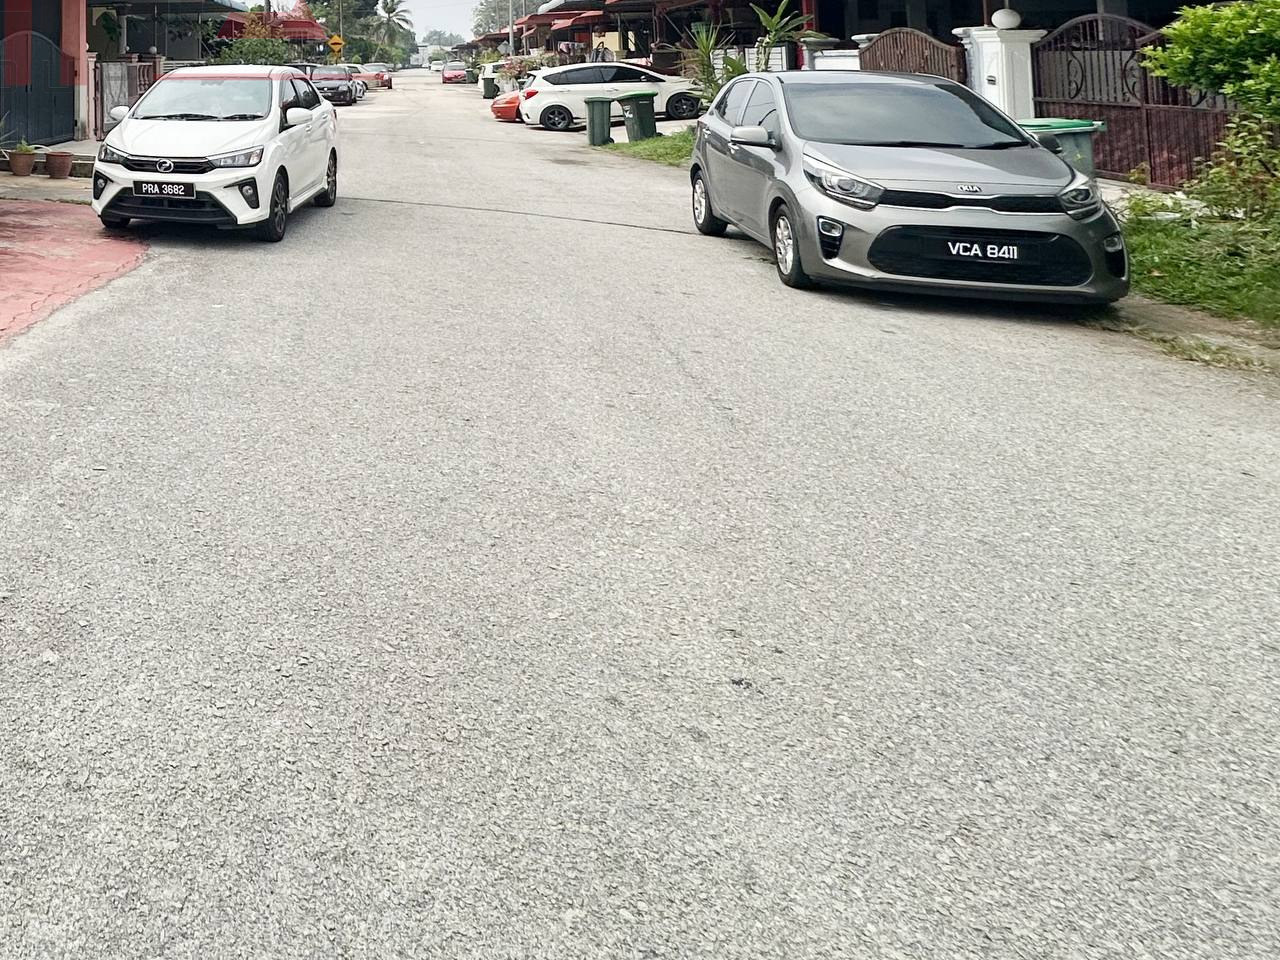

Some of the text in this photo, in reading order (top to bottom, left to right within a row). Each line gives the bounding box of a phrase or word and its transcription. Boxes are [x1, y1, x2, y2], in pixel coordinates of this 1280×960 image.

[142, 183, 185, 195] PRA 3682
[947, 242, 1018, 259] VCA 8411
